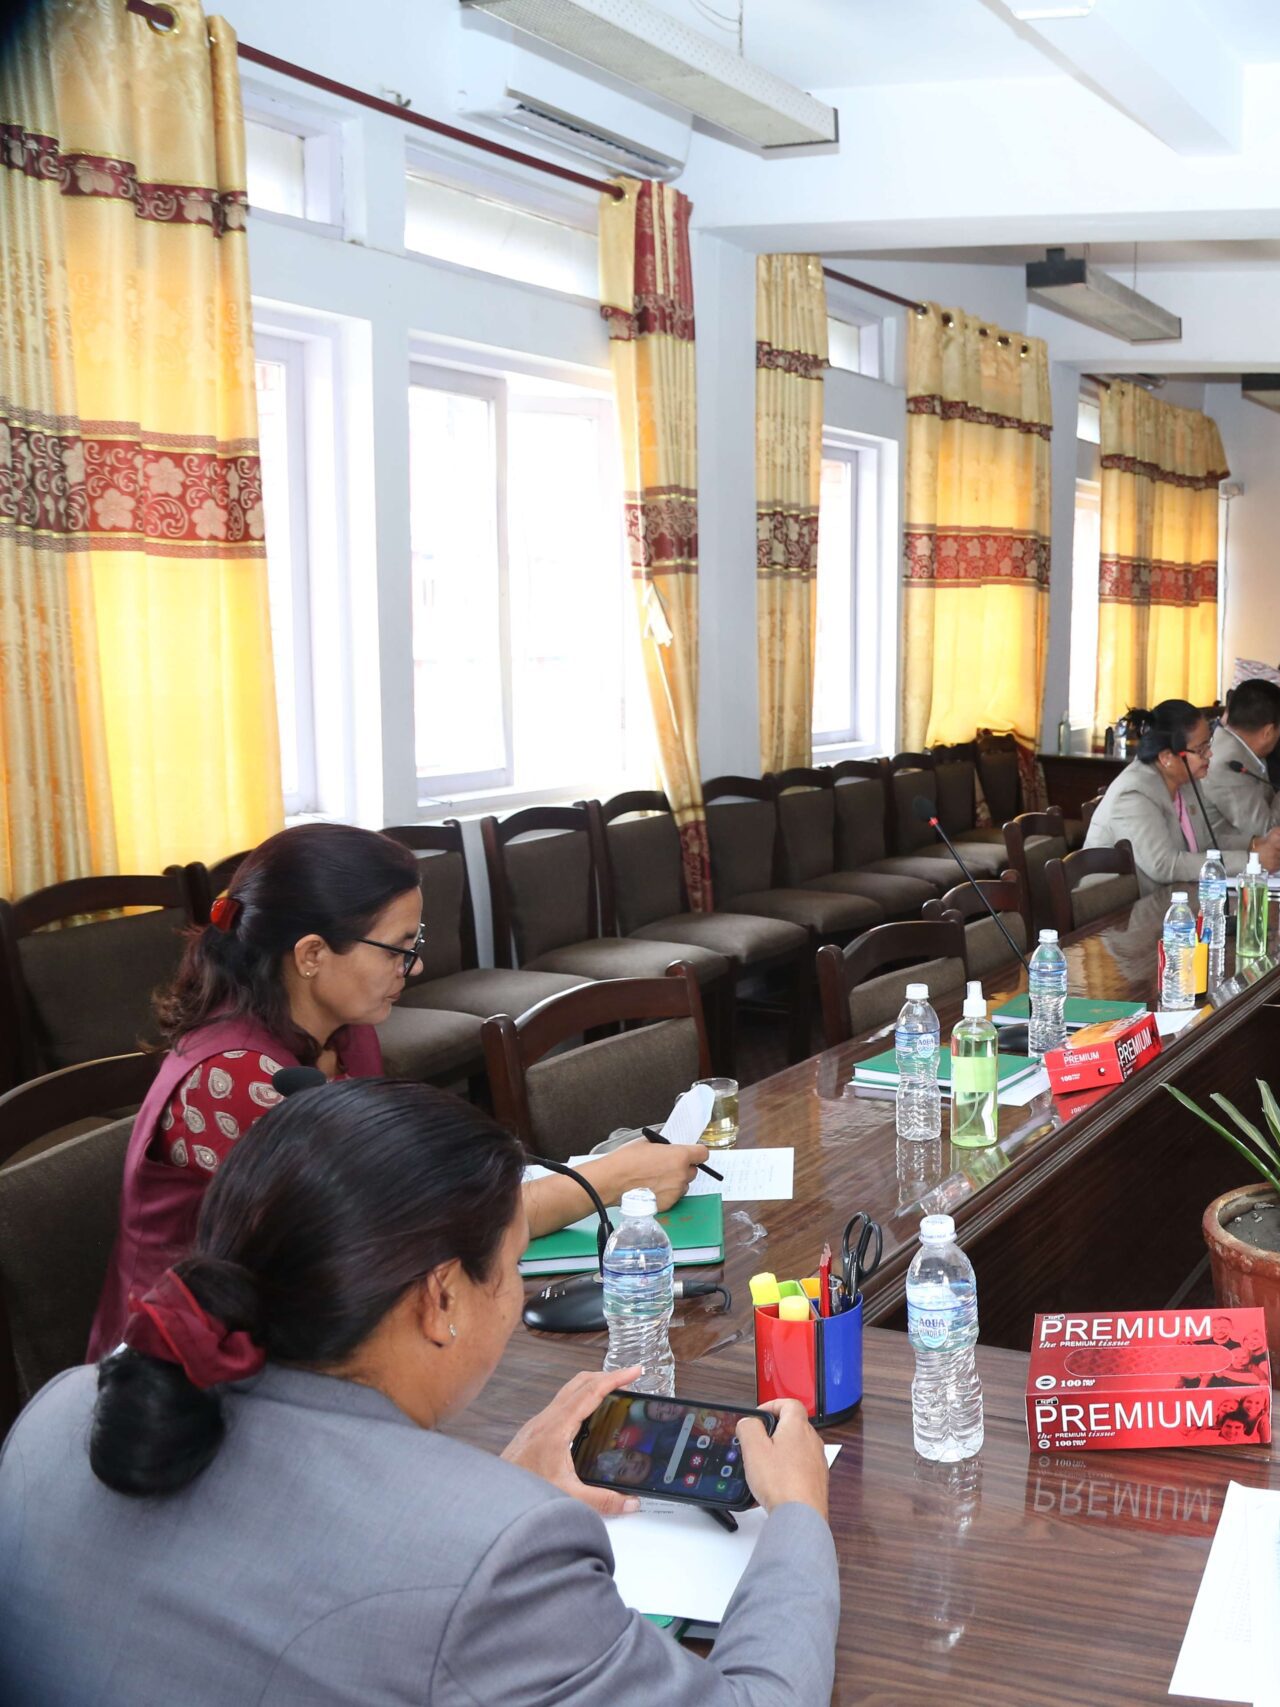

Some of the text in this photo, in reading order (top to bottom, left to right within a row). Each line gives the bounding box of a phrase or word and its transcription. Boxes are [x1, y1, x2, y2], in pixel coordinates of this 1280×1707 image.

[1118, 1026, 1153, 1064] PREMIUM
[1063, 1051, 1099, 1064] PREMIUM
[1060, 1074, 1073, 1082] 100
[919, 1318, 945, 1327] AQUA
[1039, 1315, 1211, 1341] PREMIUM
[1039, 1341, 1057, 1349] the
[1098, 1339, 1131, 1347] tissue
[1060, 1379, 1081, 1388] 100
[1035, 1400, 1213, 1432] PREMIUM
[1037, 1432, 1053, 1440] the
[1088, 1430, 1116, 1438] tissue
